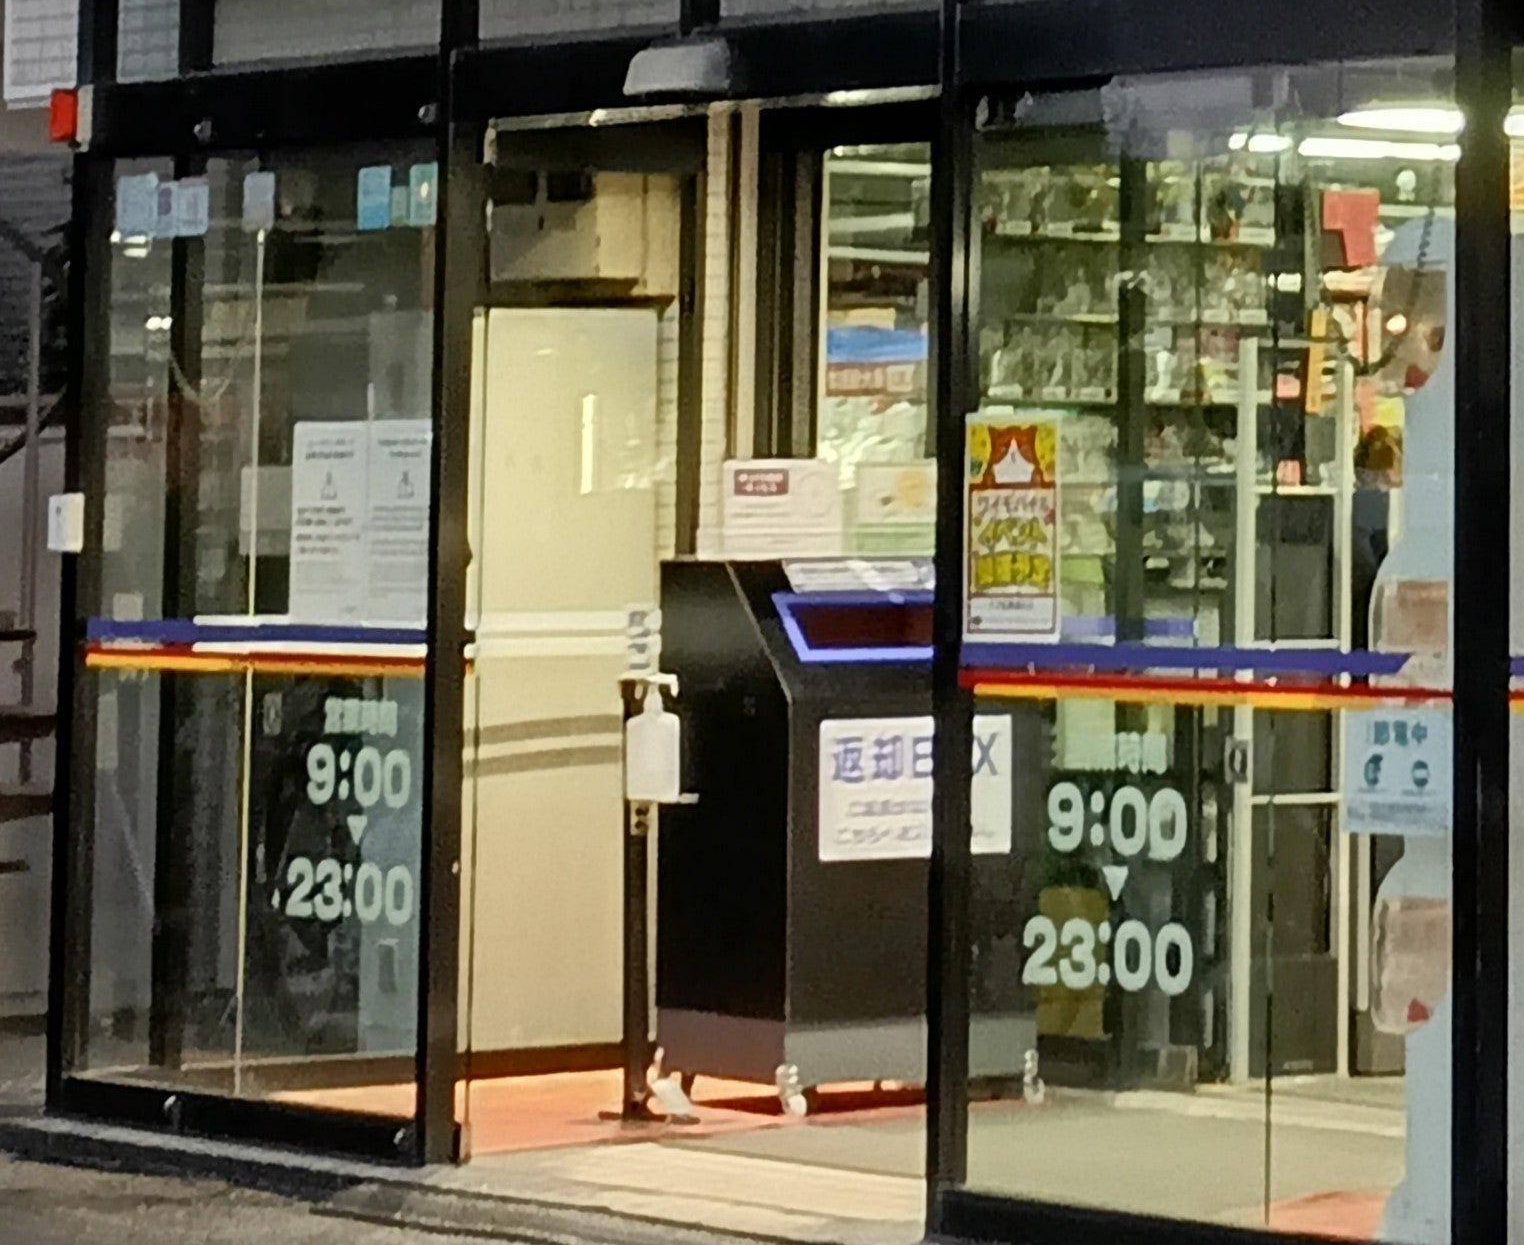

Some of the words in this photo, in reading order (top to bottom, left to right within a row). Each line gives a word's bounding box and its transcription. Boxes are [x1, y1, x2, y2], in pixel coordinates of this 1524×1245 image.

[306, 742, 412, 809] 9:00
[832, 732, 999, 783] 返却BX
[1046, 781, 1188, 862] 9:00
[285, 856, 414, 925] 23:00
[1021, 915, 1194, 996] 23:00
